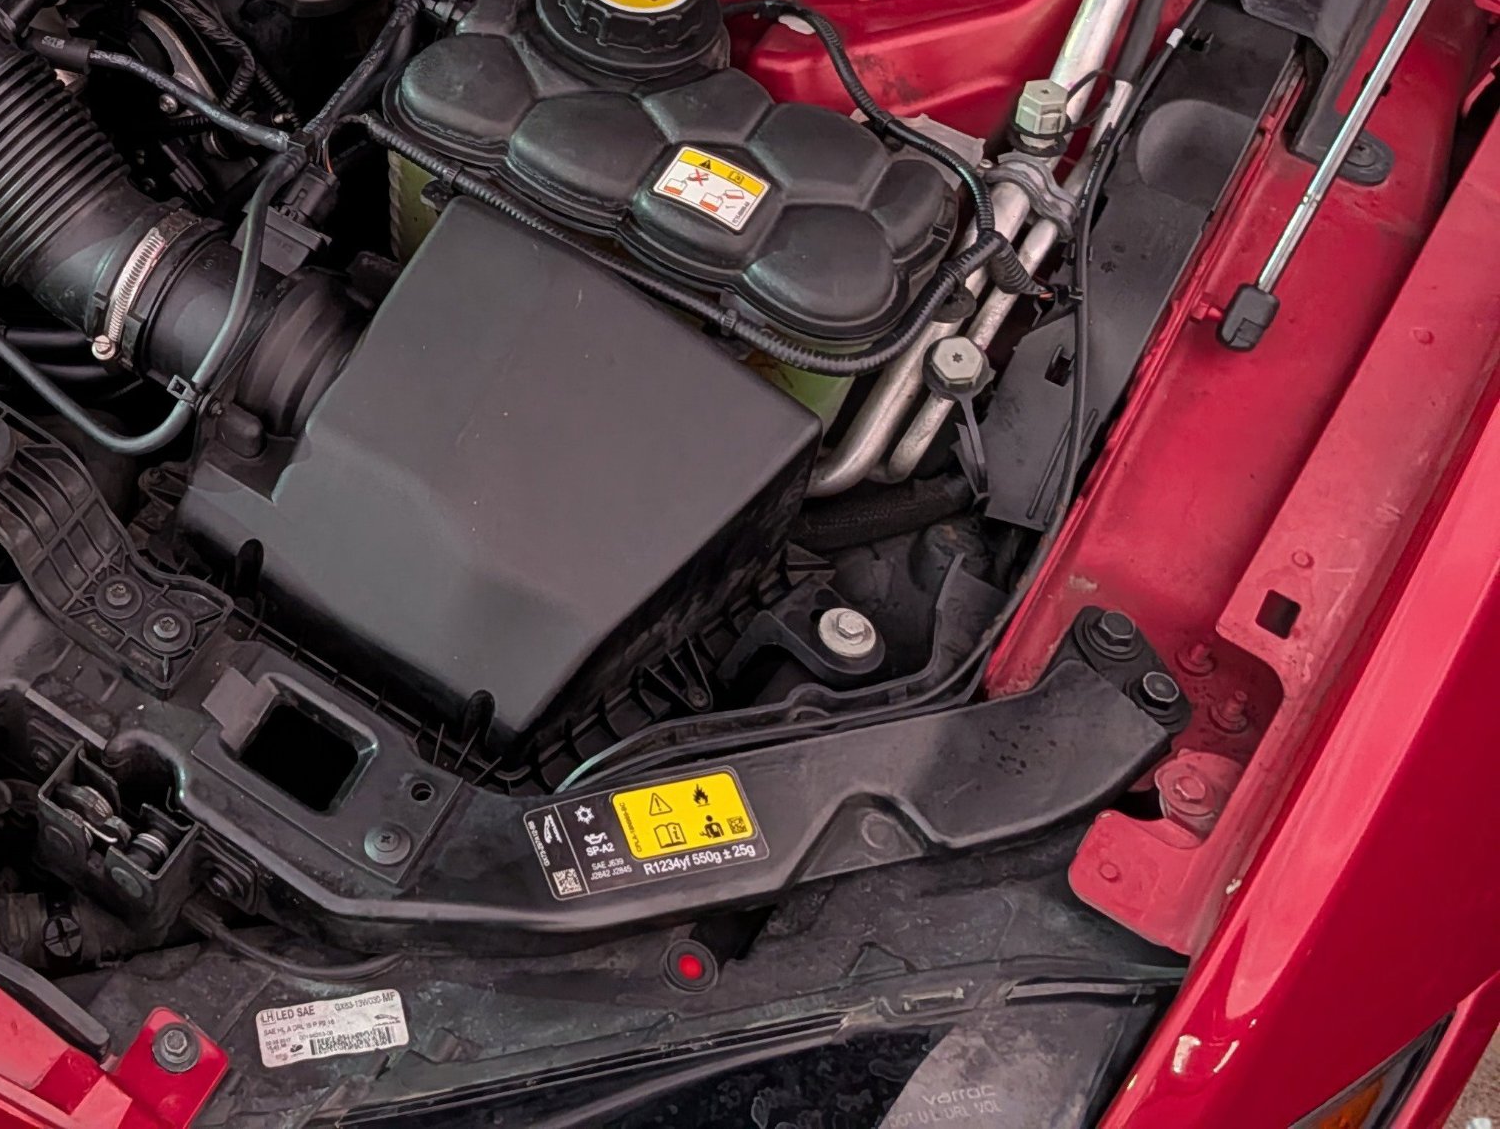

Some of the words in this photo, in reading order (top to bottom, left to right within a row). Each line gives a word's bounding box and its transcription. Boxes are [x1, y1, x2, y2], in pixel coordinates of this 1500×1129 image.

[585, 842, 615, 857] SP-A2
[591, 860, 607, 870] SAE
[607, 858, 625, 868] J639
[643, 855, 691, 875] R1234yf
[692, 851, 722, 865] 550g
[732, 844, 756, 858] 25g
[261, 1011, 275, 1023] LH
[276, 1009, 295, 1021] LED
[297, 1005, 316, 1017] SAE
[922, 1085, 997, 1105] varroc
